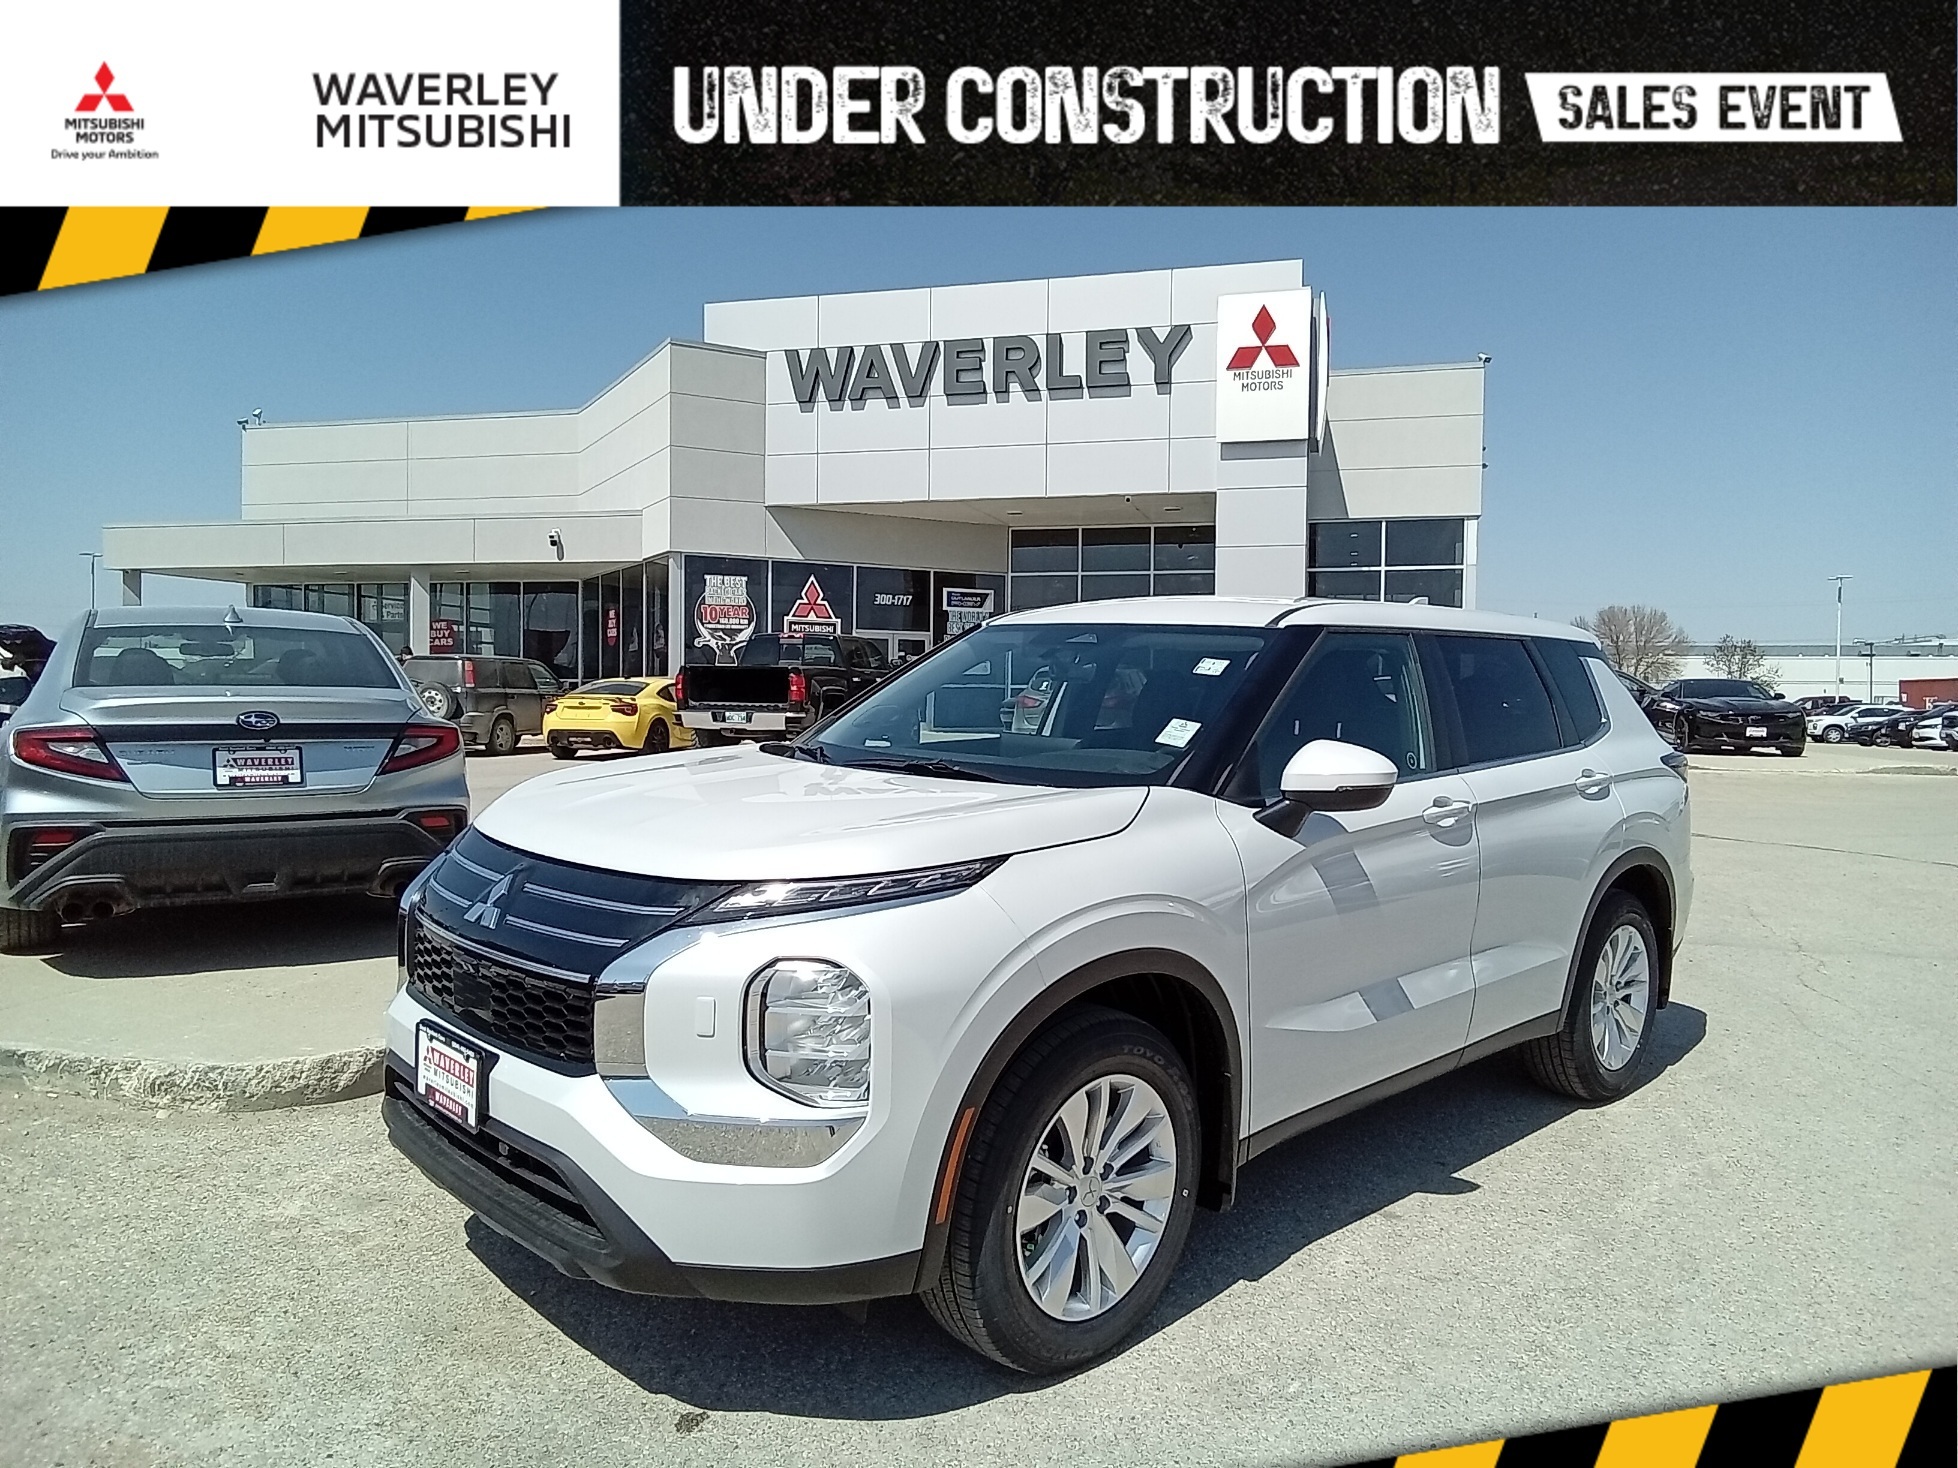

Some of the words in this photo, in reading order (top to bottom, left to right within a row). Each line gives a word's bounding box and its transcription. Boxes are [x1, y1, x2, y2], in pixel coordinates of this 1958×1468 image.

[785, 325, 1193, 412] WAVERLEY
[1233, 369, 1293, 381] MITSUBISHI
[1241, 381, 1284, 392] MOTORS
[704, 574, 723, 587] THE
[723, 575, 748, 588] BEST
[873, 593, 913, 606] 300-1717
[701, 605, 720, 624] 10
[719, 606, 750, 619] YEAR
[432, 621, 448, 629] WE
[791, 623, 835, 633] MITSUBISHI
[430, 630, 450, 638] BUY
[429, 638, 454, 646] CARS
[236, 758, 294, 766] WAVERLEY
[433, 1049, 475, 1087] WAVERLEY
[433, 1066, 475, 1099] MITSUBISHI
